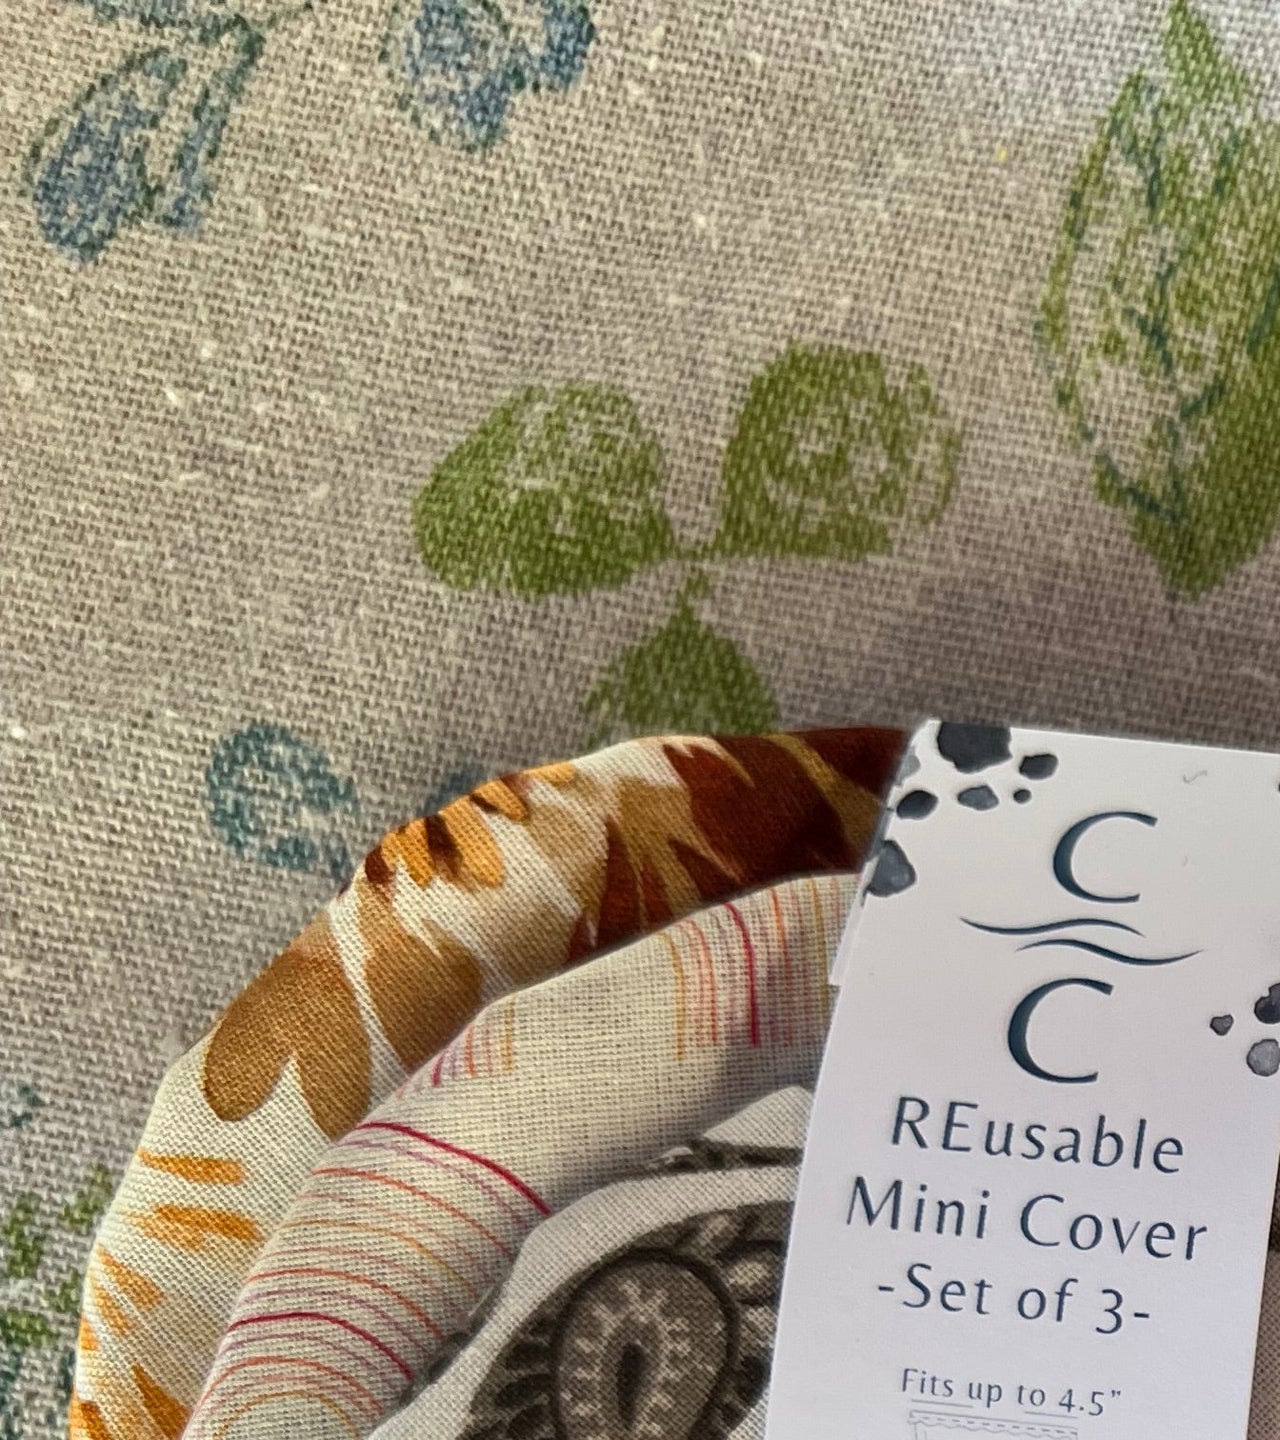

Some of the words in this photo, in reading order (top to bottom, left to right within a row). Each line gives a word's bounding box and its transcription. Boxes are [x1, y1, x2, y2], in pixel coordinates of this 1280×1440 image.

[1053, 811, 1158, 903] C
[1007, 978, 1113, 1083] C
[891, 1097, 1184, 1173] REusable
[845, 1176, 989, 1239] Mini
[1020, 1194, 1207, 1261] Cover
[878, 1263, 990, 1315] -Set
[1017, 1278, 1077, 1323] of
[1095, 1289, 1150, 1334] 3-
[902, 1368, 954, 1398] Fits
[968, 1381, 1001, 1404] up
[1018, 1383, 1046, 1407] to
